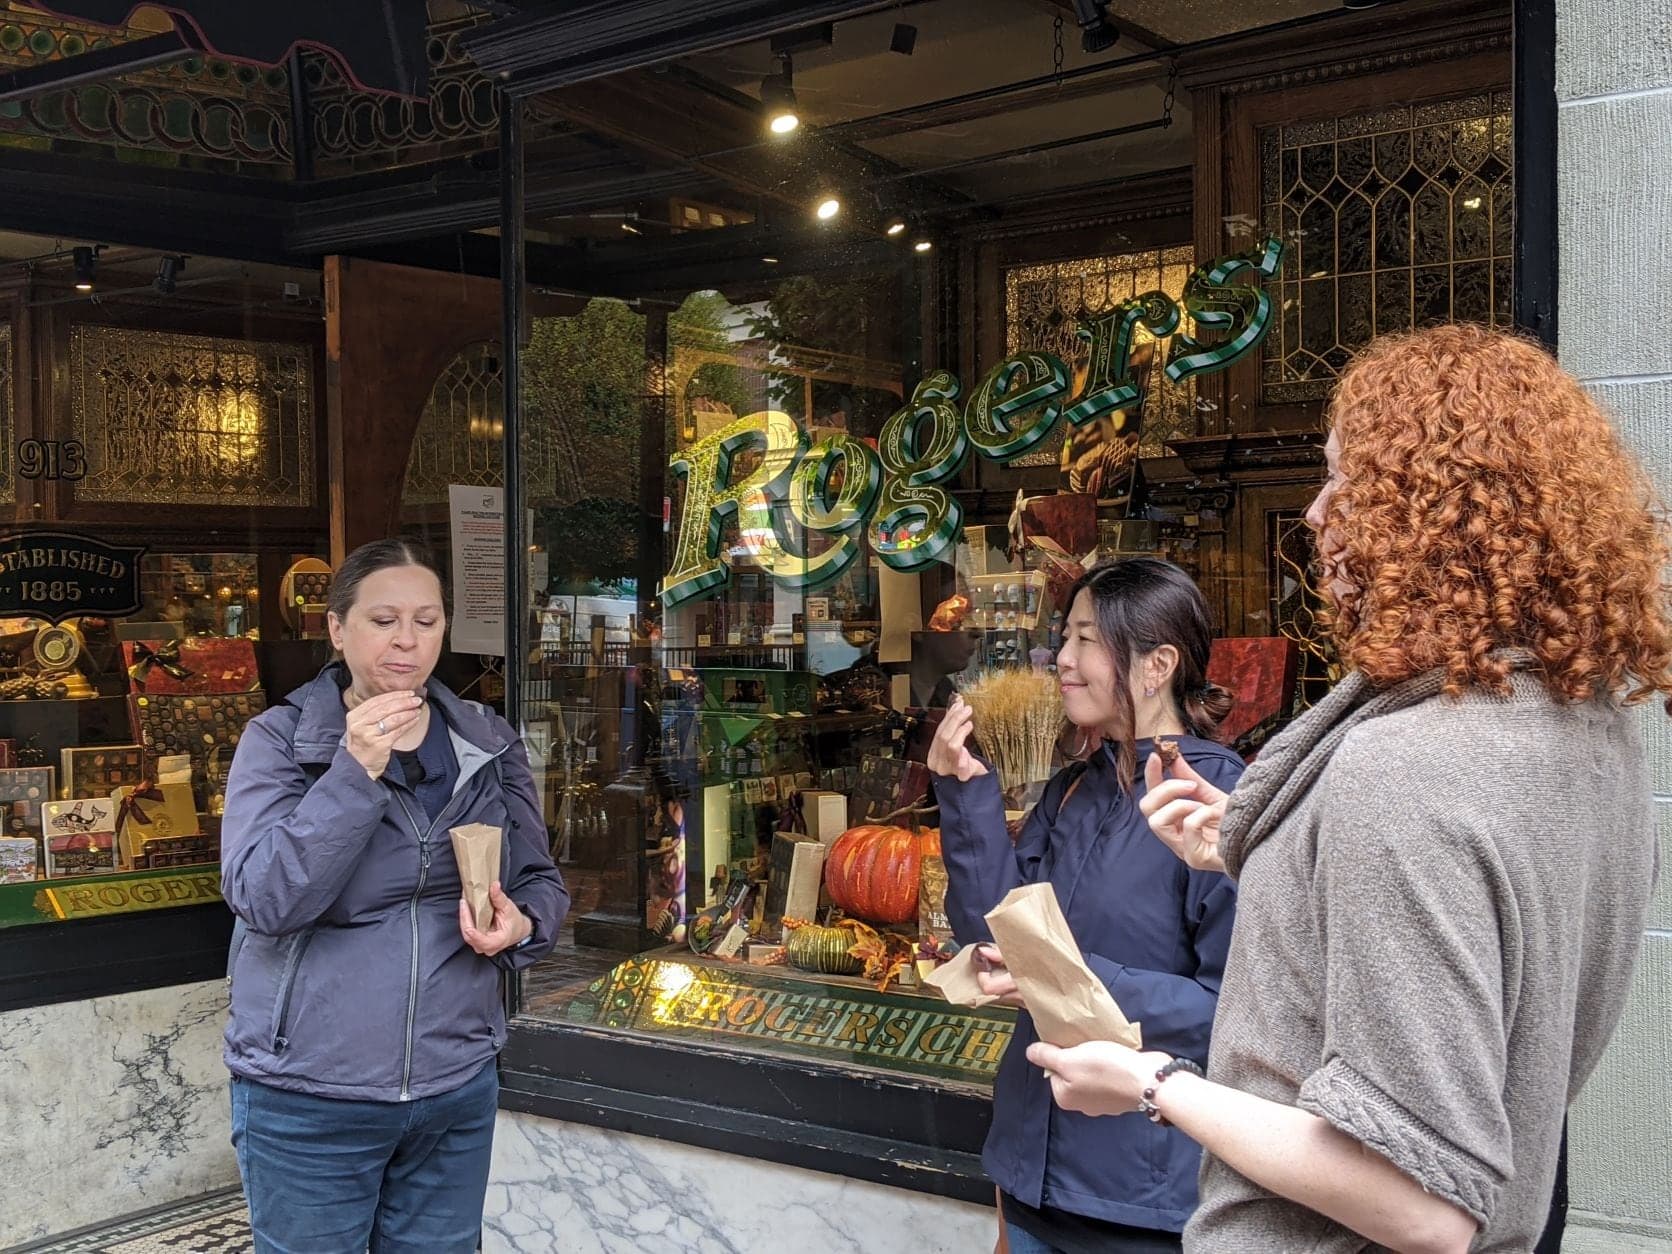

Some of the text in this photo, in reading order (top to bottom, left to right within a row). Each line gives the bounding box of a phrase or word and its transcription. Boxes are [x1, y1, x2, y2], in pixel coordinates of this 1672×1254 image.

[656, 234, 1285, 608] Rogers
[18, 438, 87, 481] 913
[20, 581, 83, 601] 1885
[64, 876, 222, 912] ROGER
[932, 920, 952, 929] BA
[692, 992, 1014, 1064] ROGERS CH
